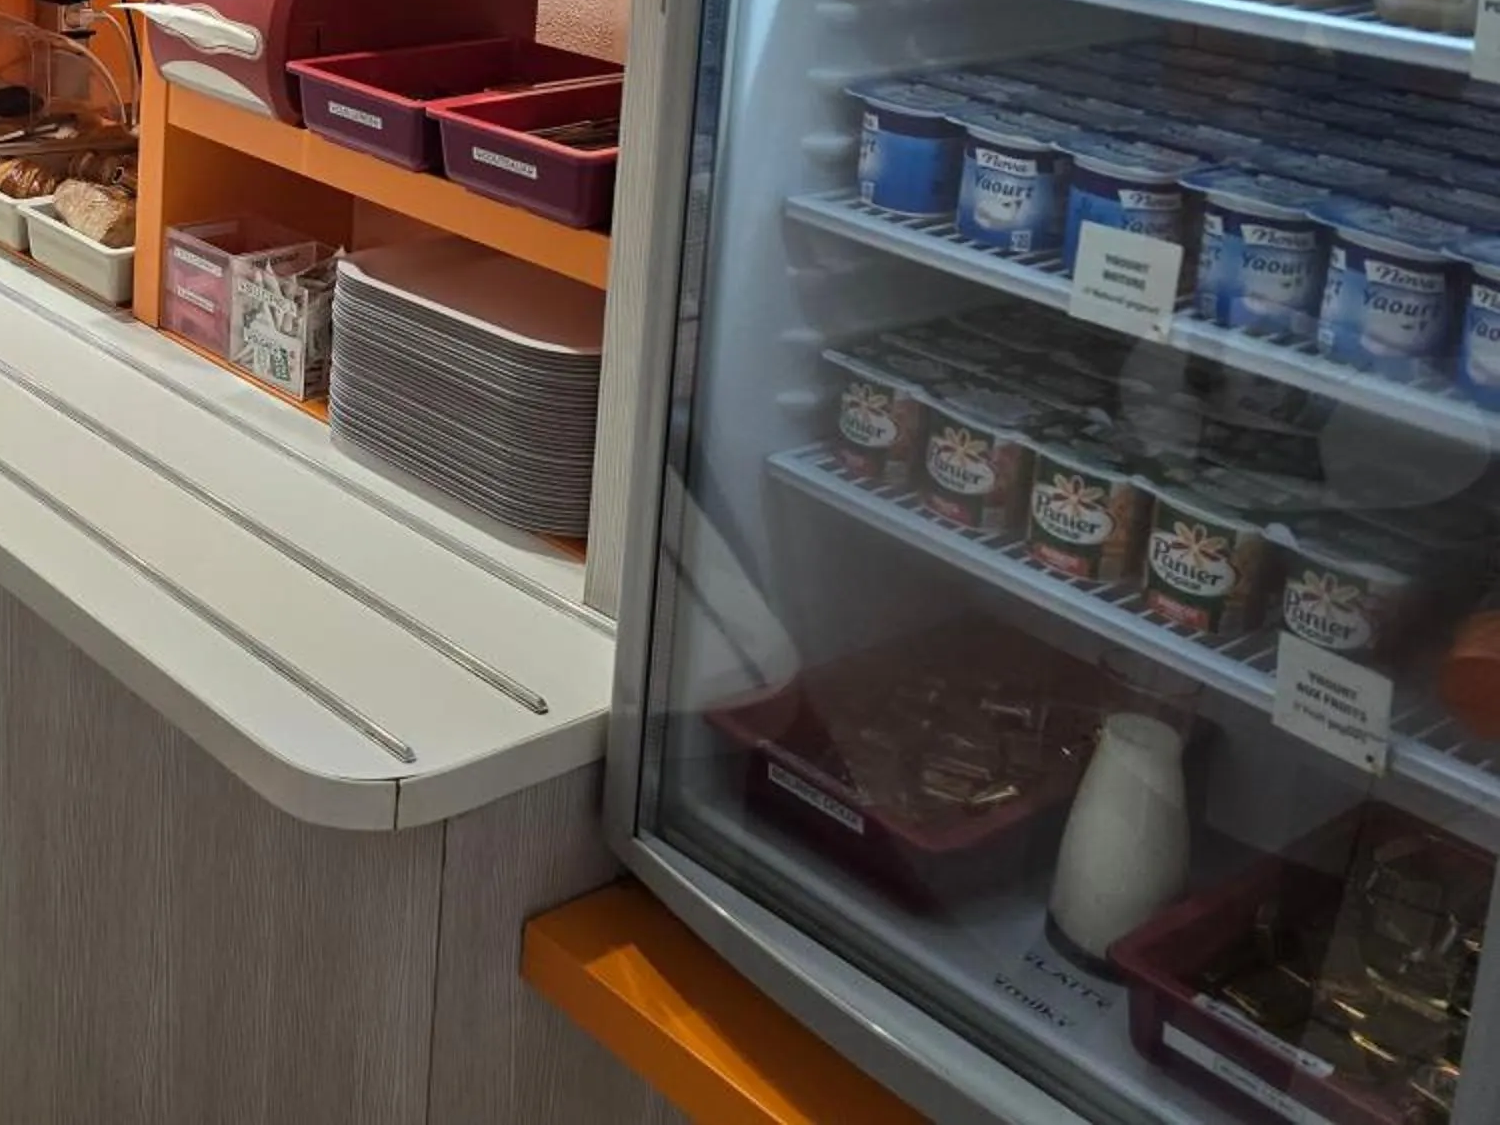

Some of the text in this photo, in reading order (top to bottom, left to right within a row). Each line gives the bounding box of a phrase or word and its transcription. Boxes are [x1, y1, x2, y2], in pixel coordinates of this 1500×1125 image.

[974, 169, 1036, 200] Yaourt
[1036, 490, 1102, 535] Panier
[1153, 536, 1225, 587] Panier
[1285, 588, 1358, 641] Panier
